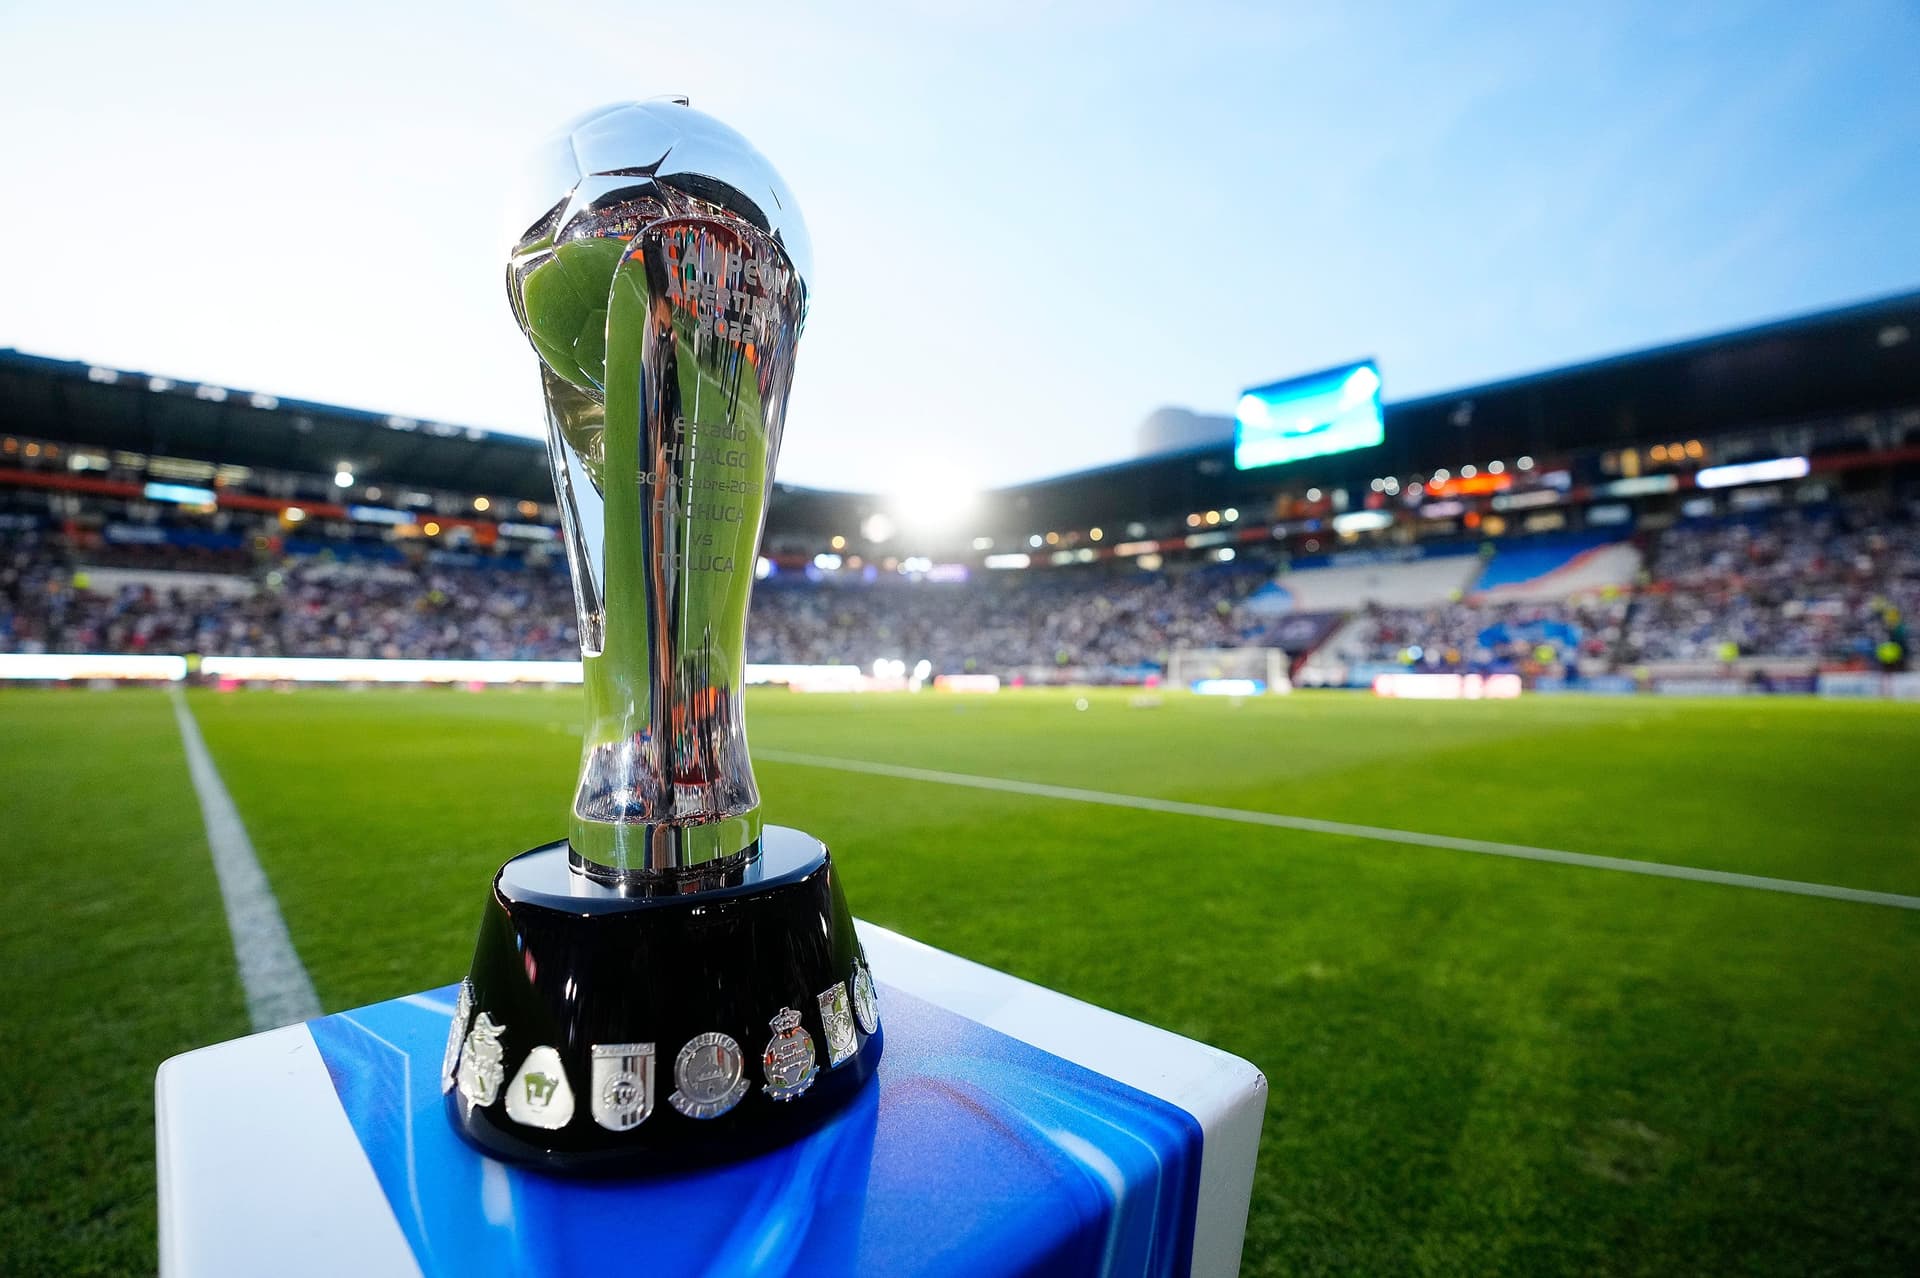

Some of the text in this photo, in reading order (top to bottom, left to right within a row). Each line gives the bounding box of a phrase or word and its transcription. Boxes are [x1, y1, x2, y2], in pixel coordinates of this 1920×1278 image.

[700, 314, 754, 344] 2022
[674, 417, 748, 442] Etadio
[663, 441, 753, 470] HIALGO
